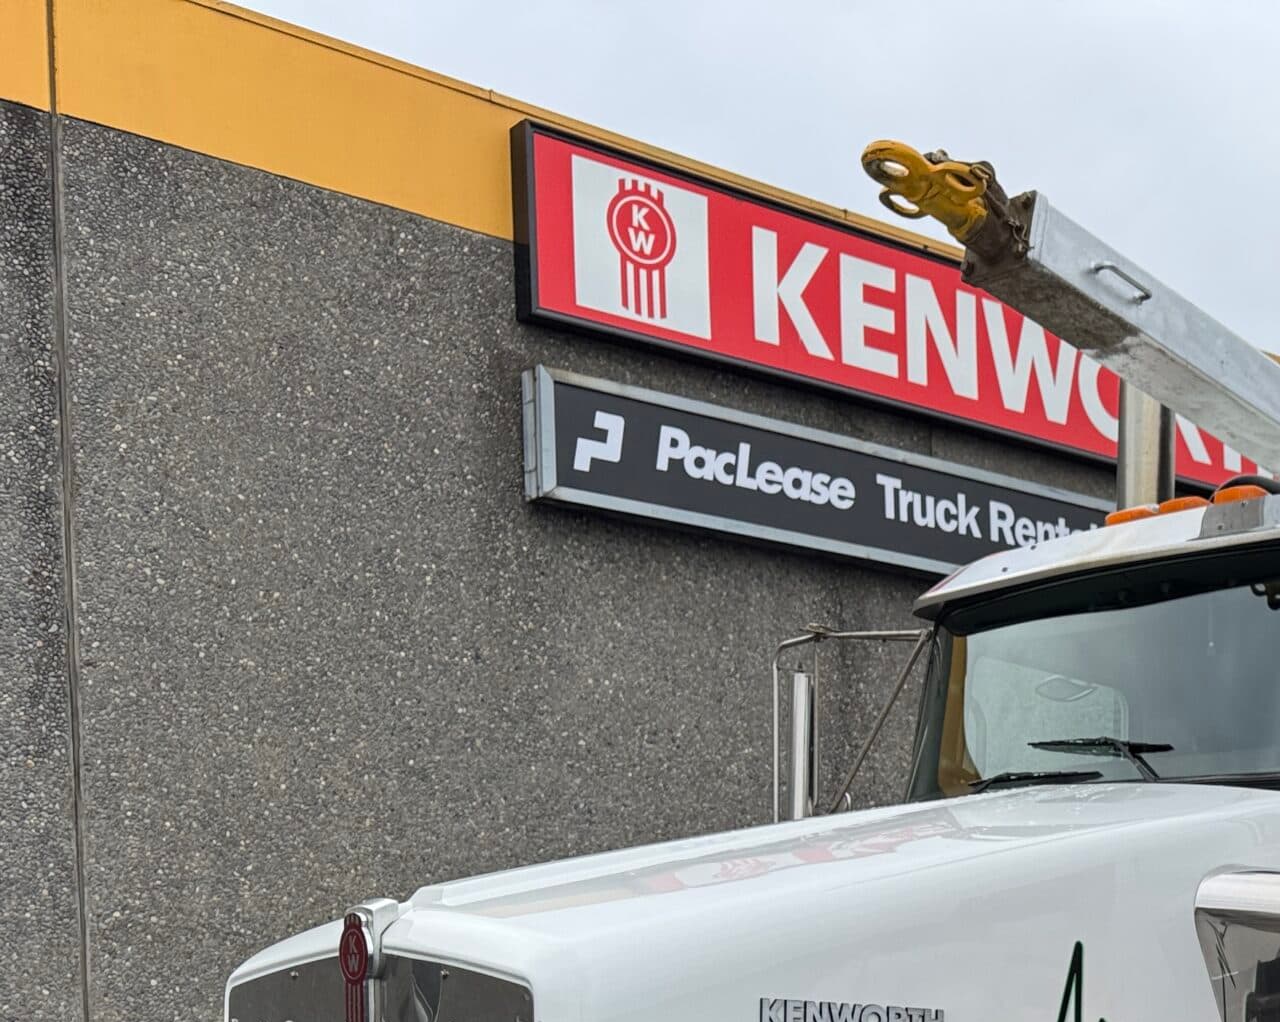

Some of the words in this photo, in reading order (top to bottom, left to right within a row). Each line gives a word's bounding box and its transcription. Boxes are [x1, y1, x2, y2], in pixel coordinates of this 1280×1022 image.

[752, 225, 1274, 479] KENW
[656, 425, 856, 510] PacLease
[876, 473, 982, 539] Truck
[989, 499, 1099, 547] Rent
